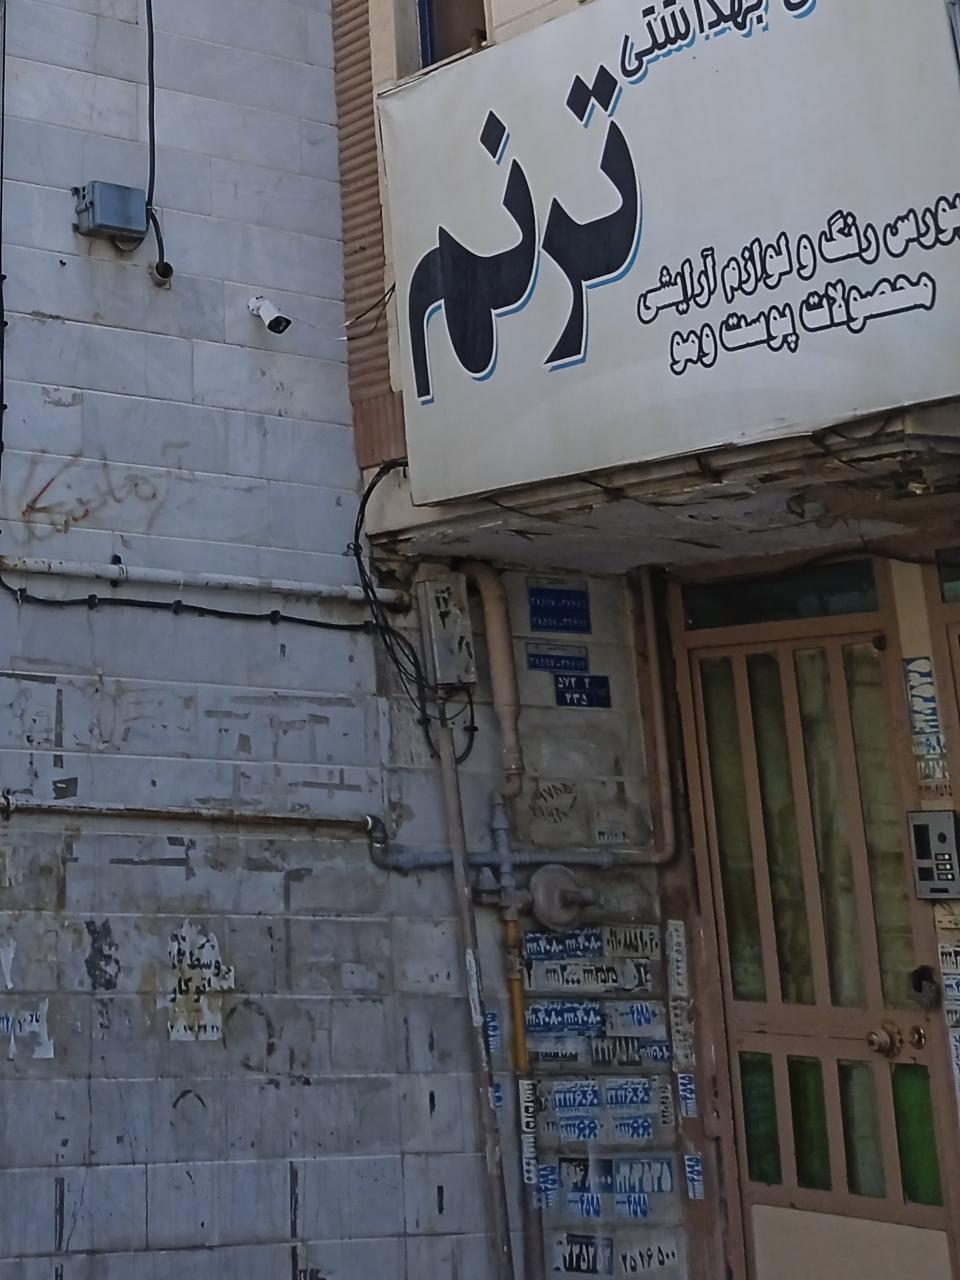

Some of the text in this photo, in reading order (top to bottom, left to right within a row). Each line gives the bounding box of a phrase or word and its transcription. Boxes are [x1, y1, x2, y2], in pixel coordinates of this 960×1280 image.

[407, 64, 642, 401] ترنم
[796, 234, 816, 280] و
[818, 210, 879, 264] رنگ
[637, 246, 717, 324] آرایشی
[721, 231, 793, 304] لوازم
[719, 302, 799, 353] پوست
[799, 271, 936, 333] محصولات
